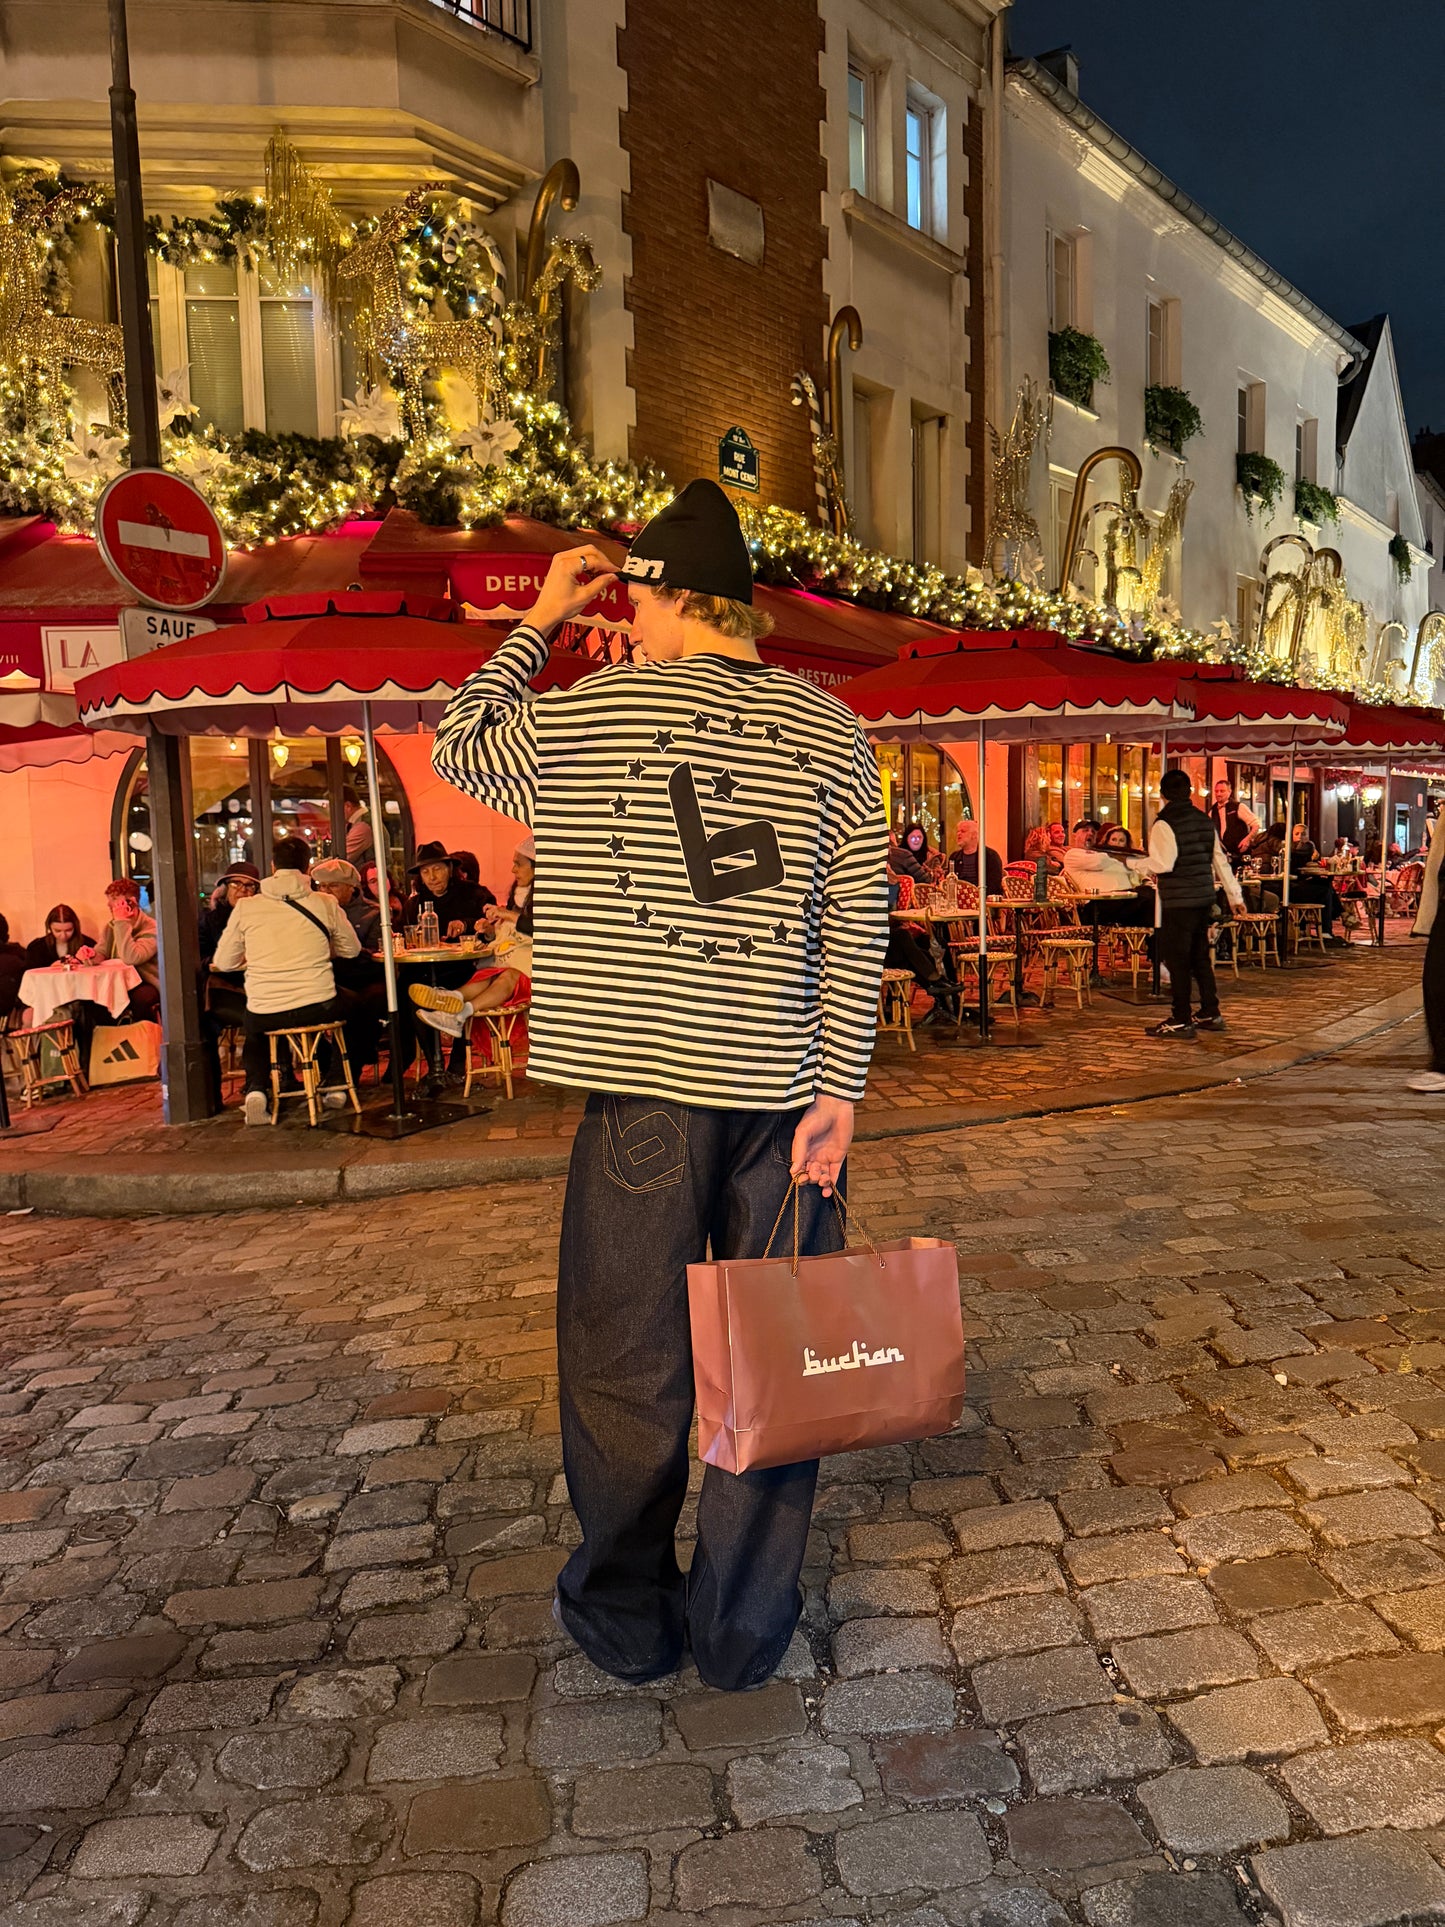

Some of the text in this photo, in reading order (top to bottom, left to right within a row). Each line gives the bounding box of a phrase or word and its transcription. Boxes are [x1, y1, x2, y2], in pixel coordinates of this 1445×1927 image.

[733, 451, 746, 464] RUE
[723, 465, 757, 485] MONT CENIS
[146, 616, 196, 639] SAUF
[60, 639, 100, 669] LA
[802, 1340, 905, 1377] buchan
